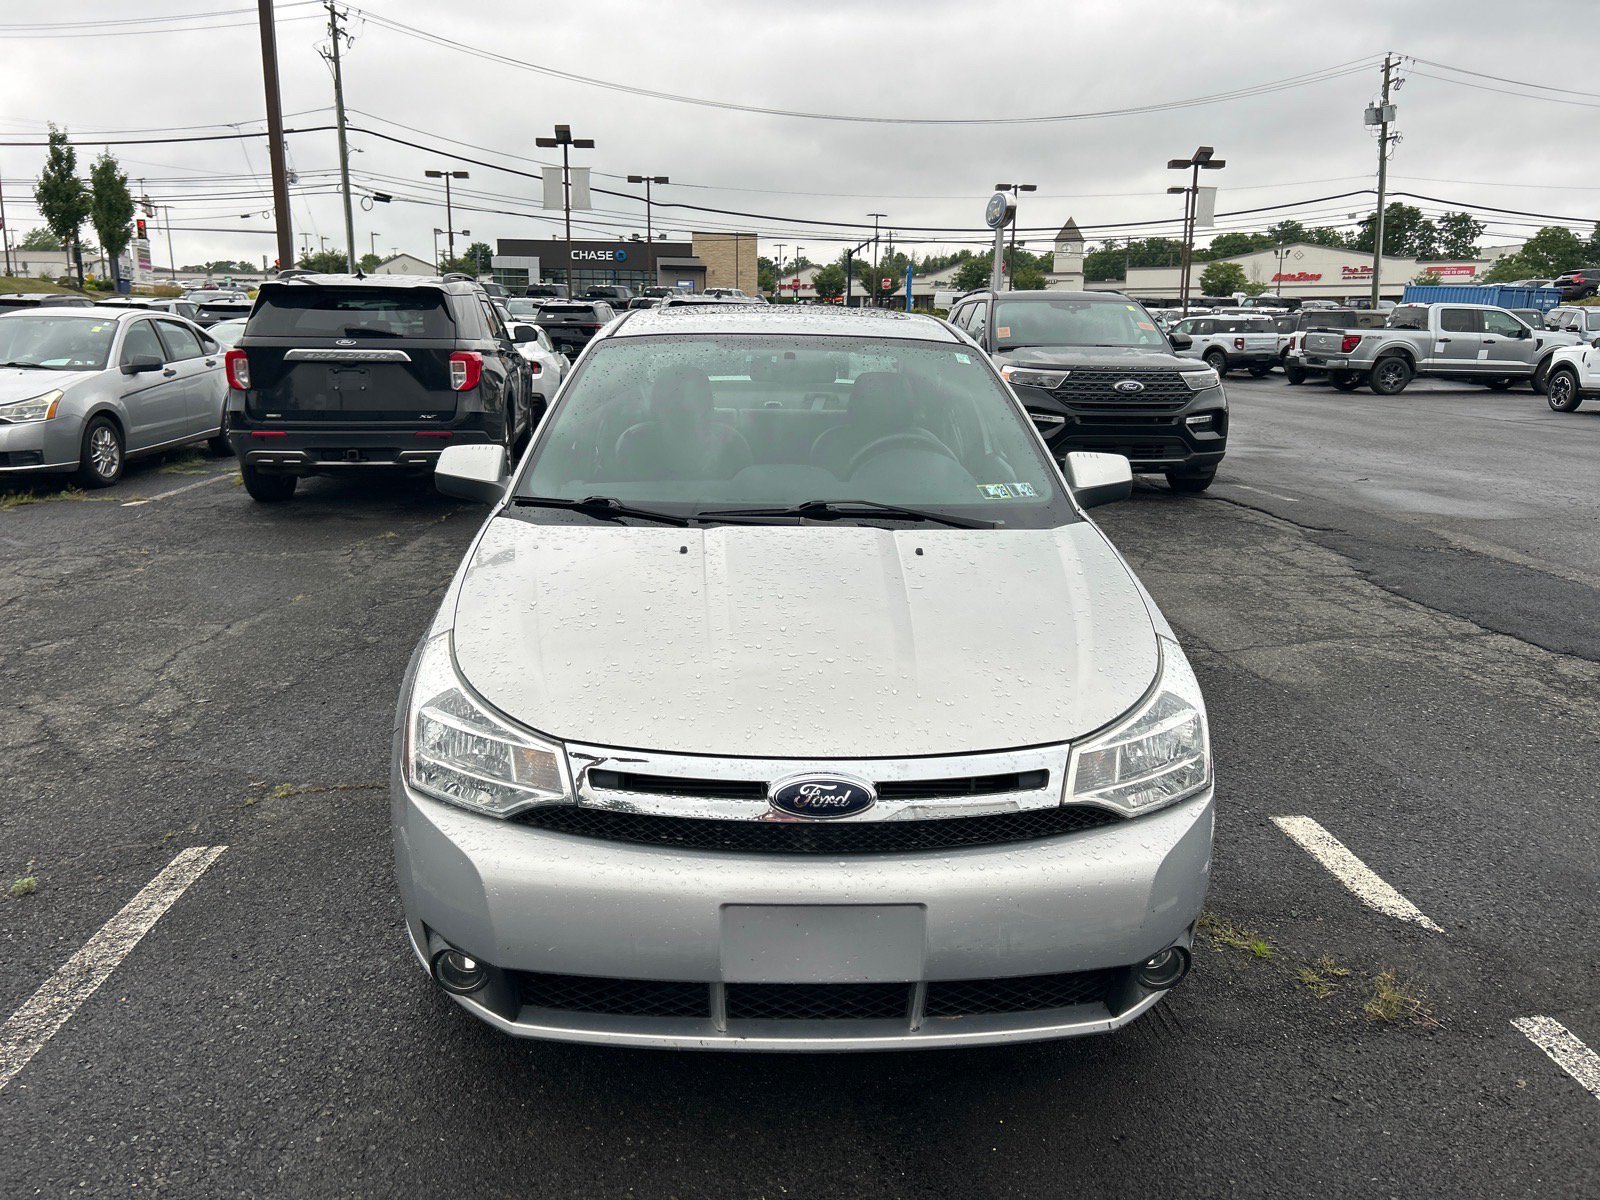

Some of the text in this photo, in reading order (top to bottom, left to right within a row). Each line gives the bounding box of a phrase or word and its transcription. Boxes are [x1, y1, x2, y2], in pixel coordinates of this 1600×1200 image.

[571, 250, 614, 261] CHASE
[1342, 266, 1359, 274] Pep
[1271, 272, 1322, 282] AutoZone
[303, 352, 388, 360] EXPLORER
[1121, 383, 1138, 392] Ford
[794, 784, 851, 807] Ford
